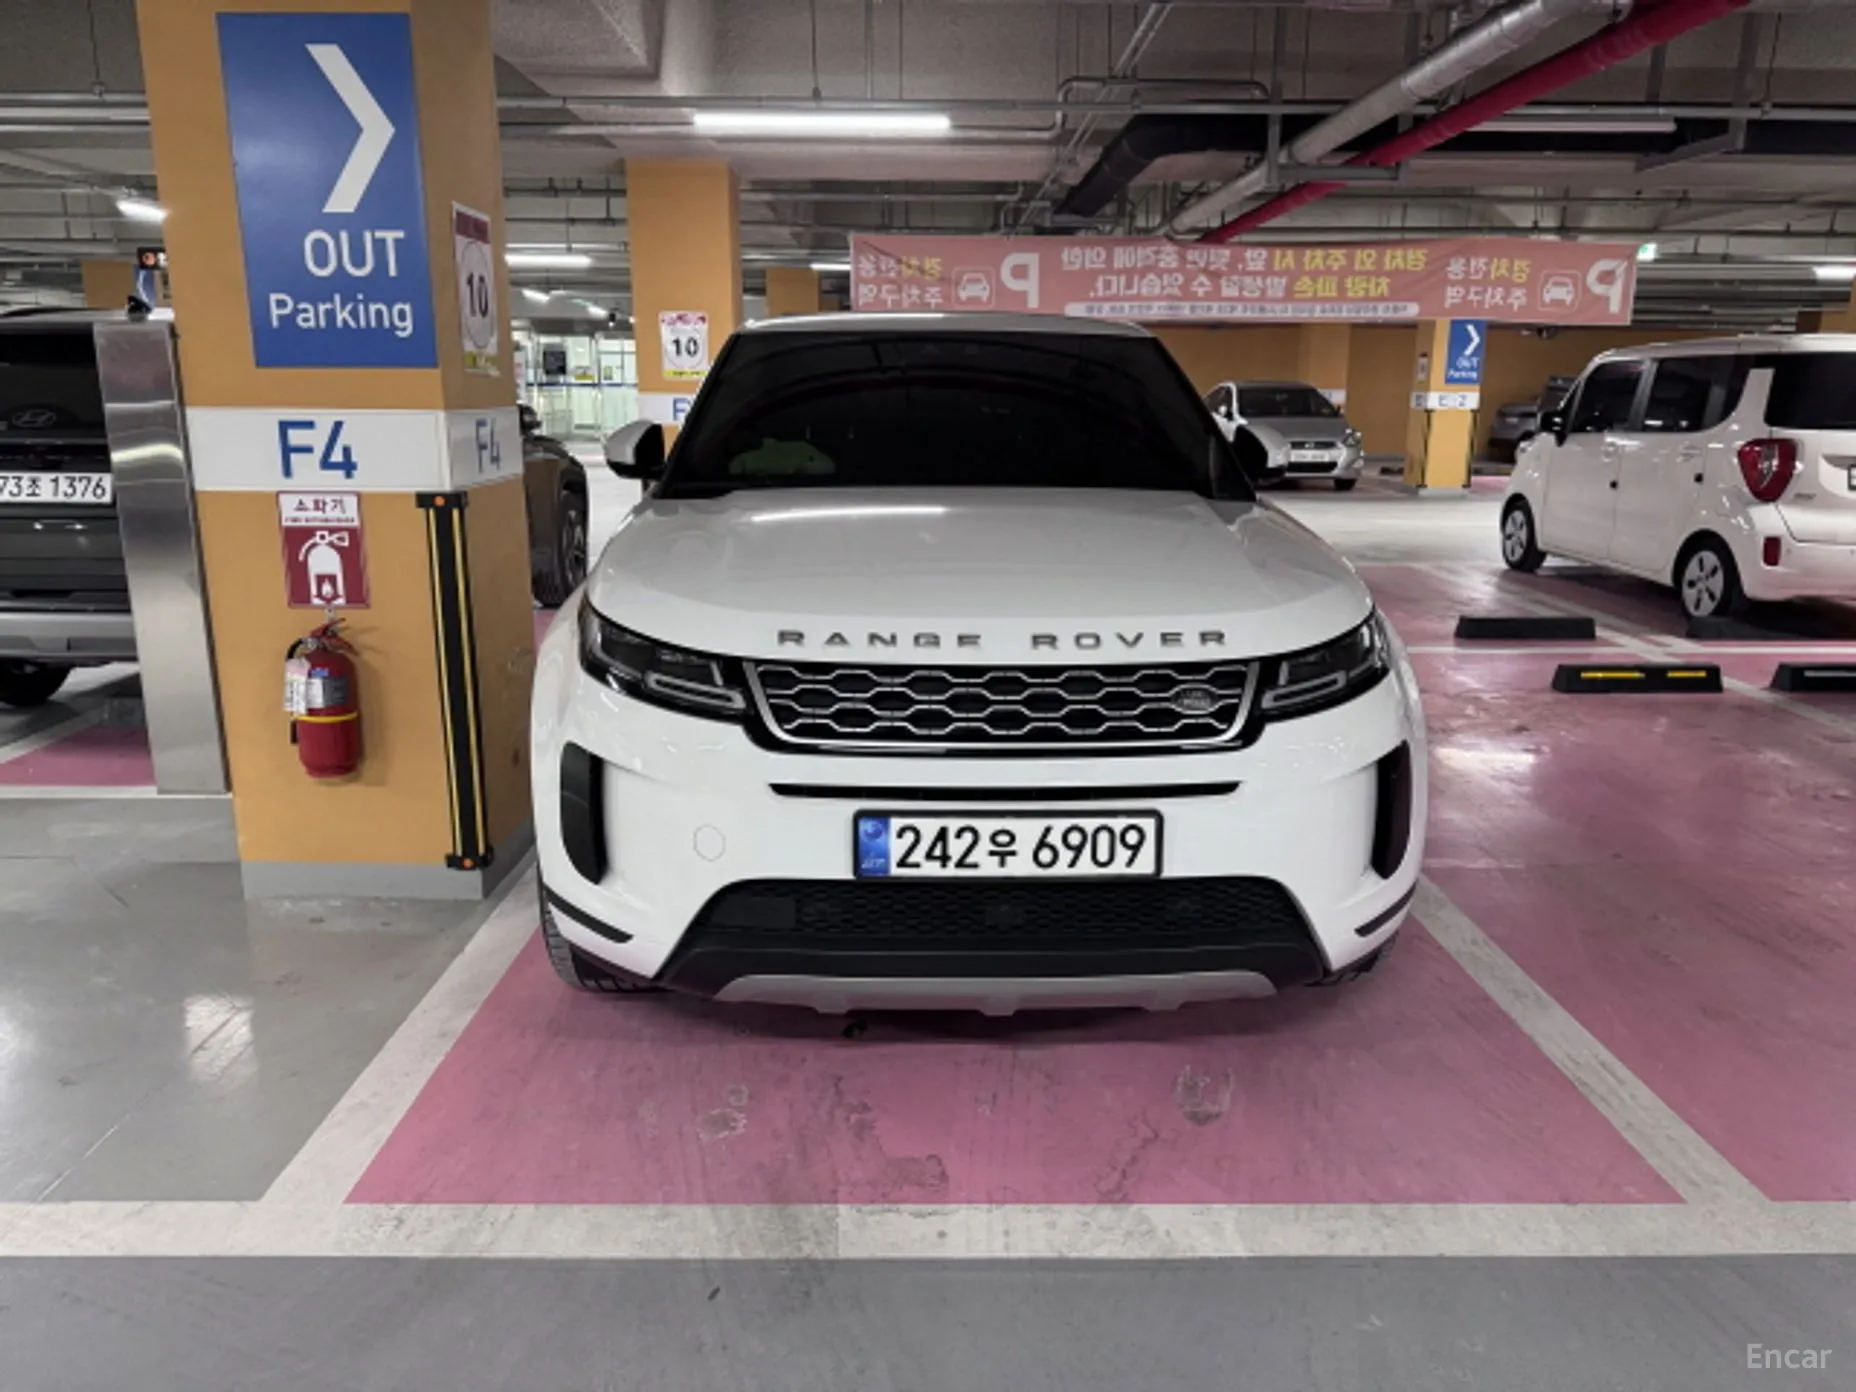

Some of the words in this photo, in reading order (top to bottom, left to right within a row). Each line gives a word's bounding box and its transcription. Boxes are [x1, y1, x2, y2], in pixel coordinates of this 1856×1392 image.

[303, 230, 404, 277] OUT
[268, 291, 413, 338] Parking
[466, 271, 489, 318] 10
[672, 337, 700, 358] 10
[277, 418, 359, 480] F4
[473, 418, 501, 474] F4
[49, 475, 106, 499] 1376
[294, 496, 347, 514] 소화기
[777, 630, 982, 649] RANGE
[1031, 630, 1227, 650] ROVER
[895, 824, 1018, 869] 242우
[1032, 823, 1147, 869] 6909
